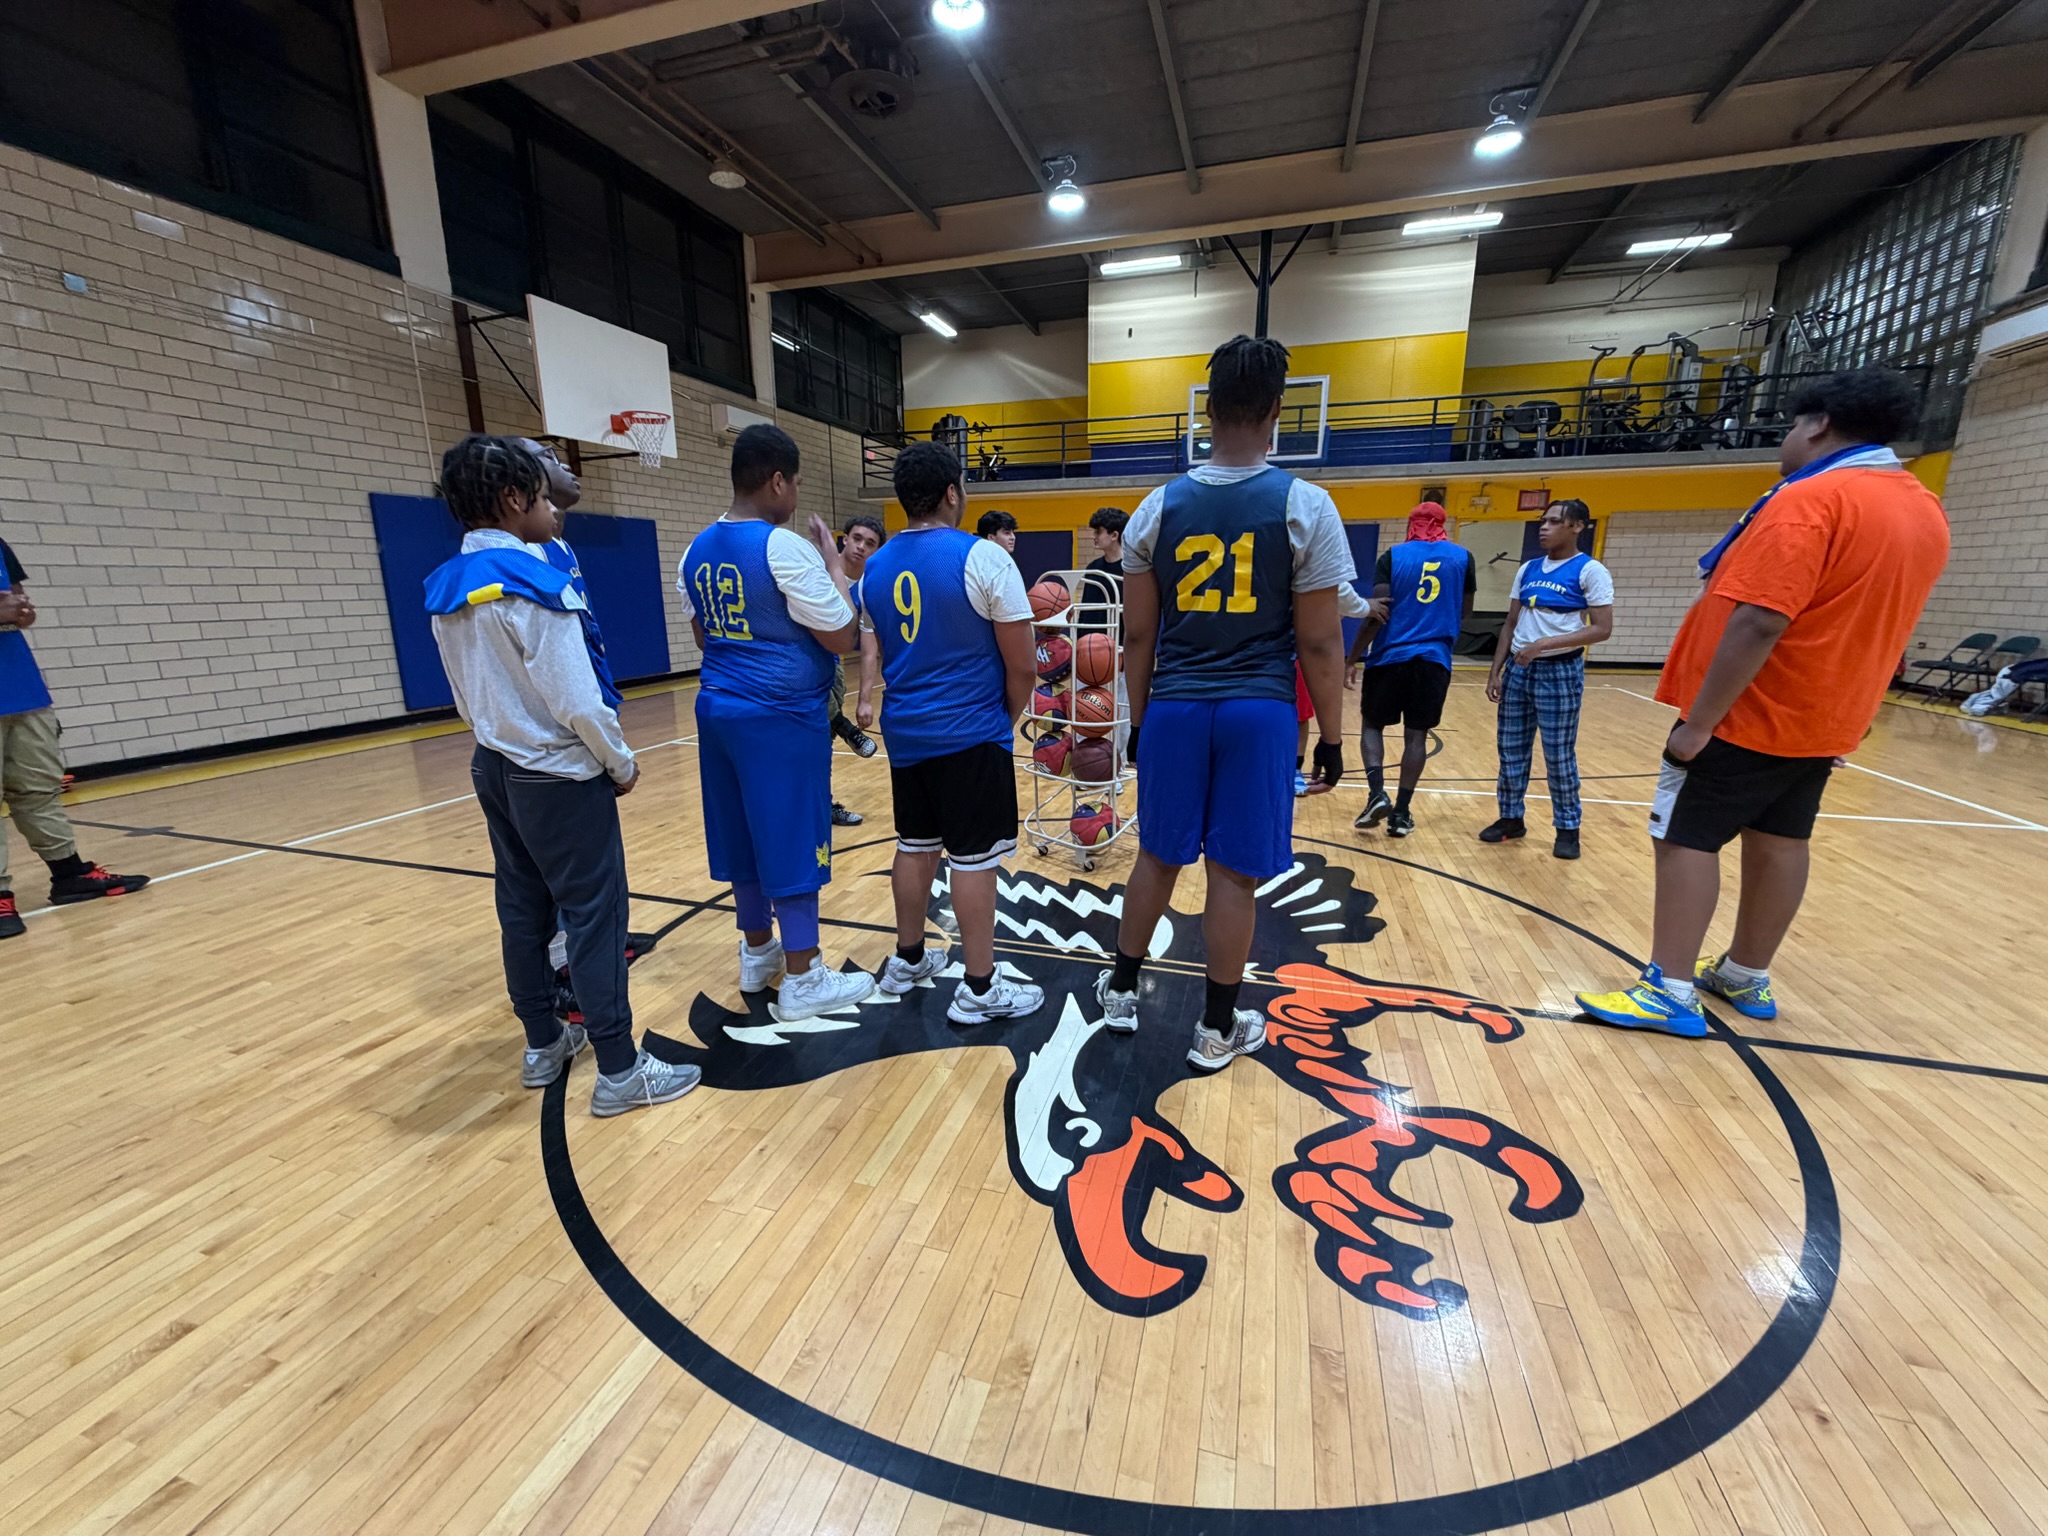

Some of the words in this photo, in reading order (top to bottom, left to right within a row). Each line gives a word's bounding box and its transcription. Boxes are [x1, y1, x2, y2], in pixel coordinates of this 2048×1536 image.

[695, 563, 753, 640] 12
[894, 571, 921, 644] 9
[1175, 532, 1257, 613] 21
[1416, 561, 1441, 604] 5
